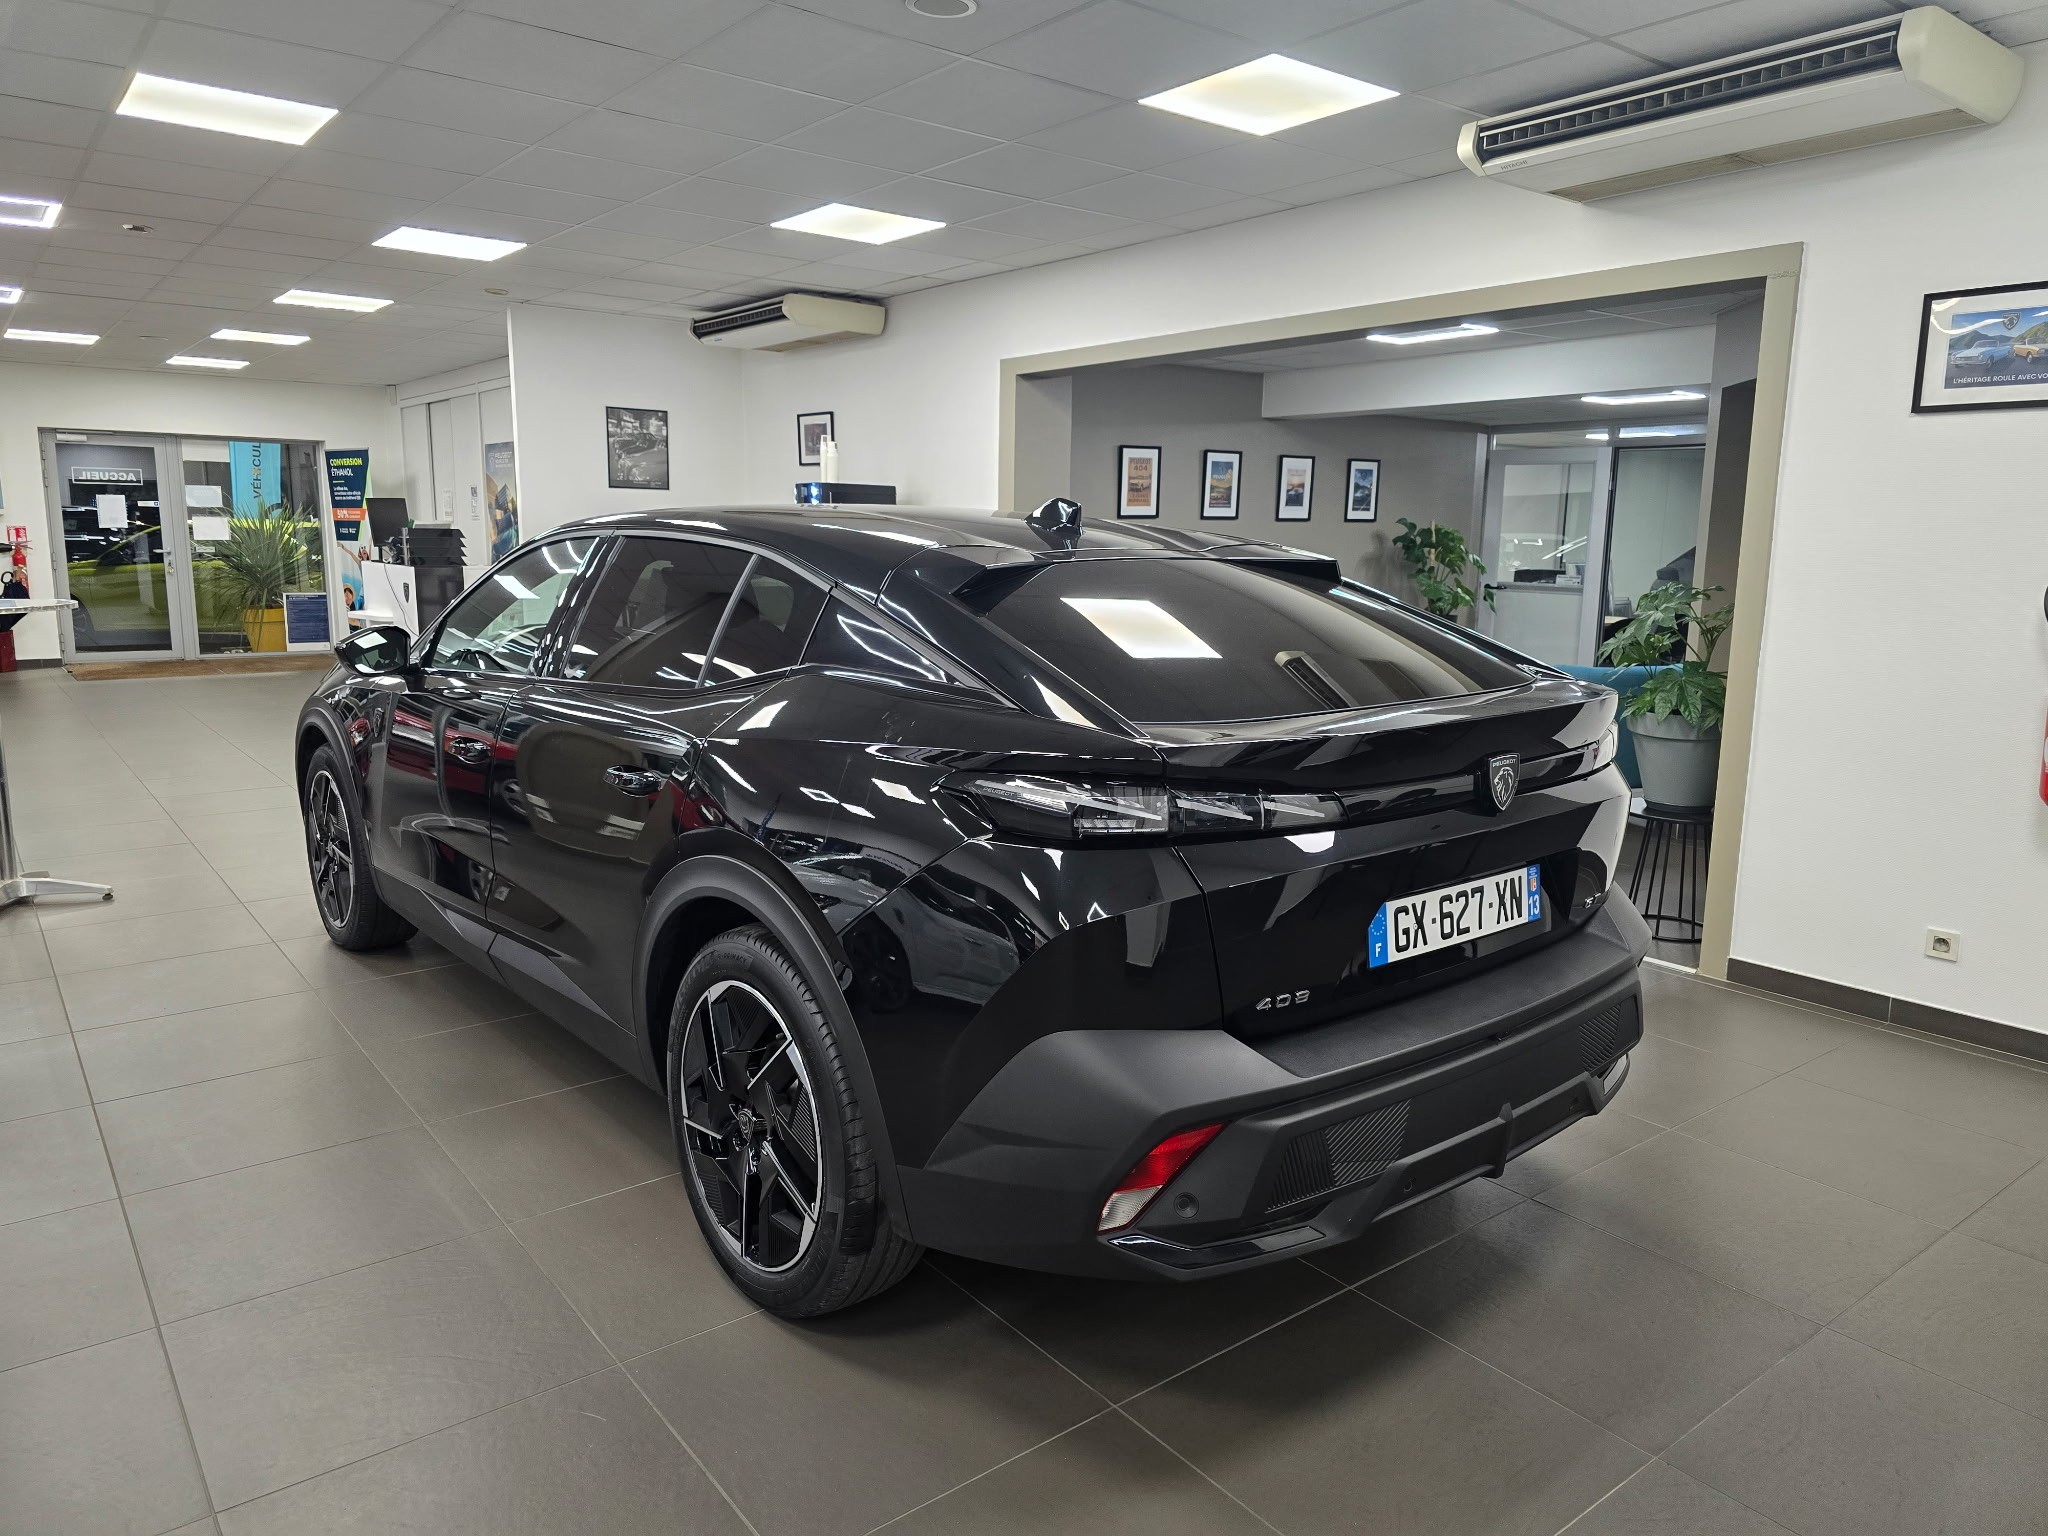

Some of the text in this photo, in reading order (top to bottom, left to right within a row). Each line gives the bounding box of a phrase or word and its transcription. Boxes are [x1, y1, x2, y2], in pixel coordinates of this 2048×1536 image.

[1500, 160, 1529, 171] HITACHI
[1953, 376, 1991, 384] L'HÉRITAGE
[1993, 374, 2016, 382] ROULE
[2017, 373, 2036, 381] AVEC
[330, 457, 363, 467] CONVERSION
[331, 467, 354, 477] ÉTHANOL
[1492, 758, 1517, 768] PEUGEOT
[983, 786, 1015, 797] PEUGEOT
[1375, 875, 1540, 958] F GX-627-XN 13
